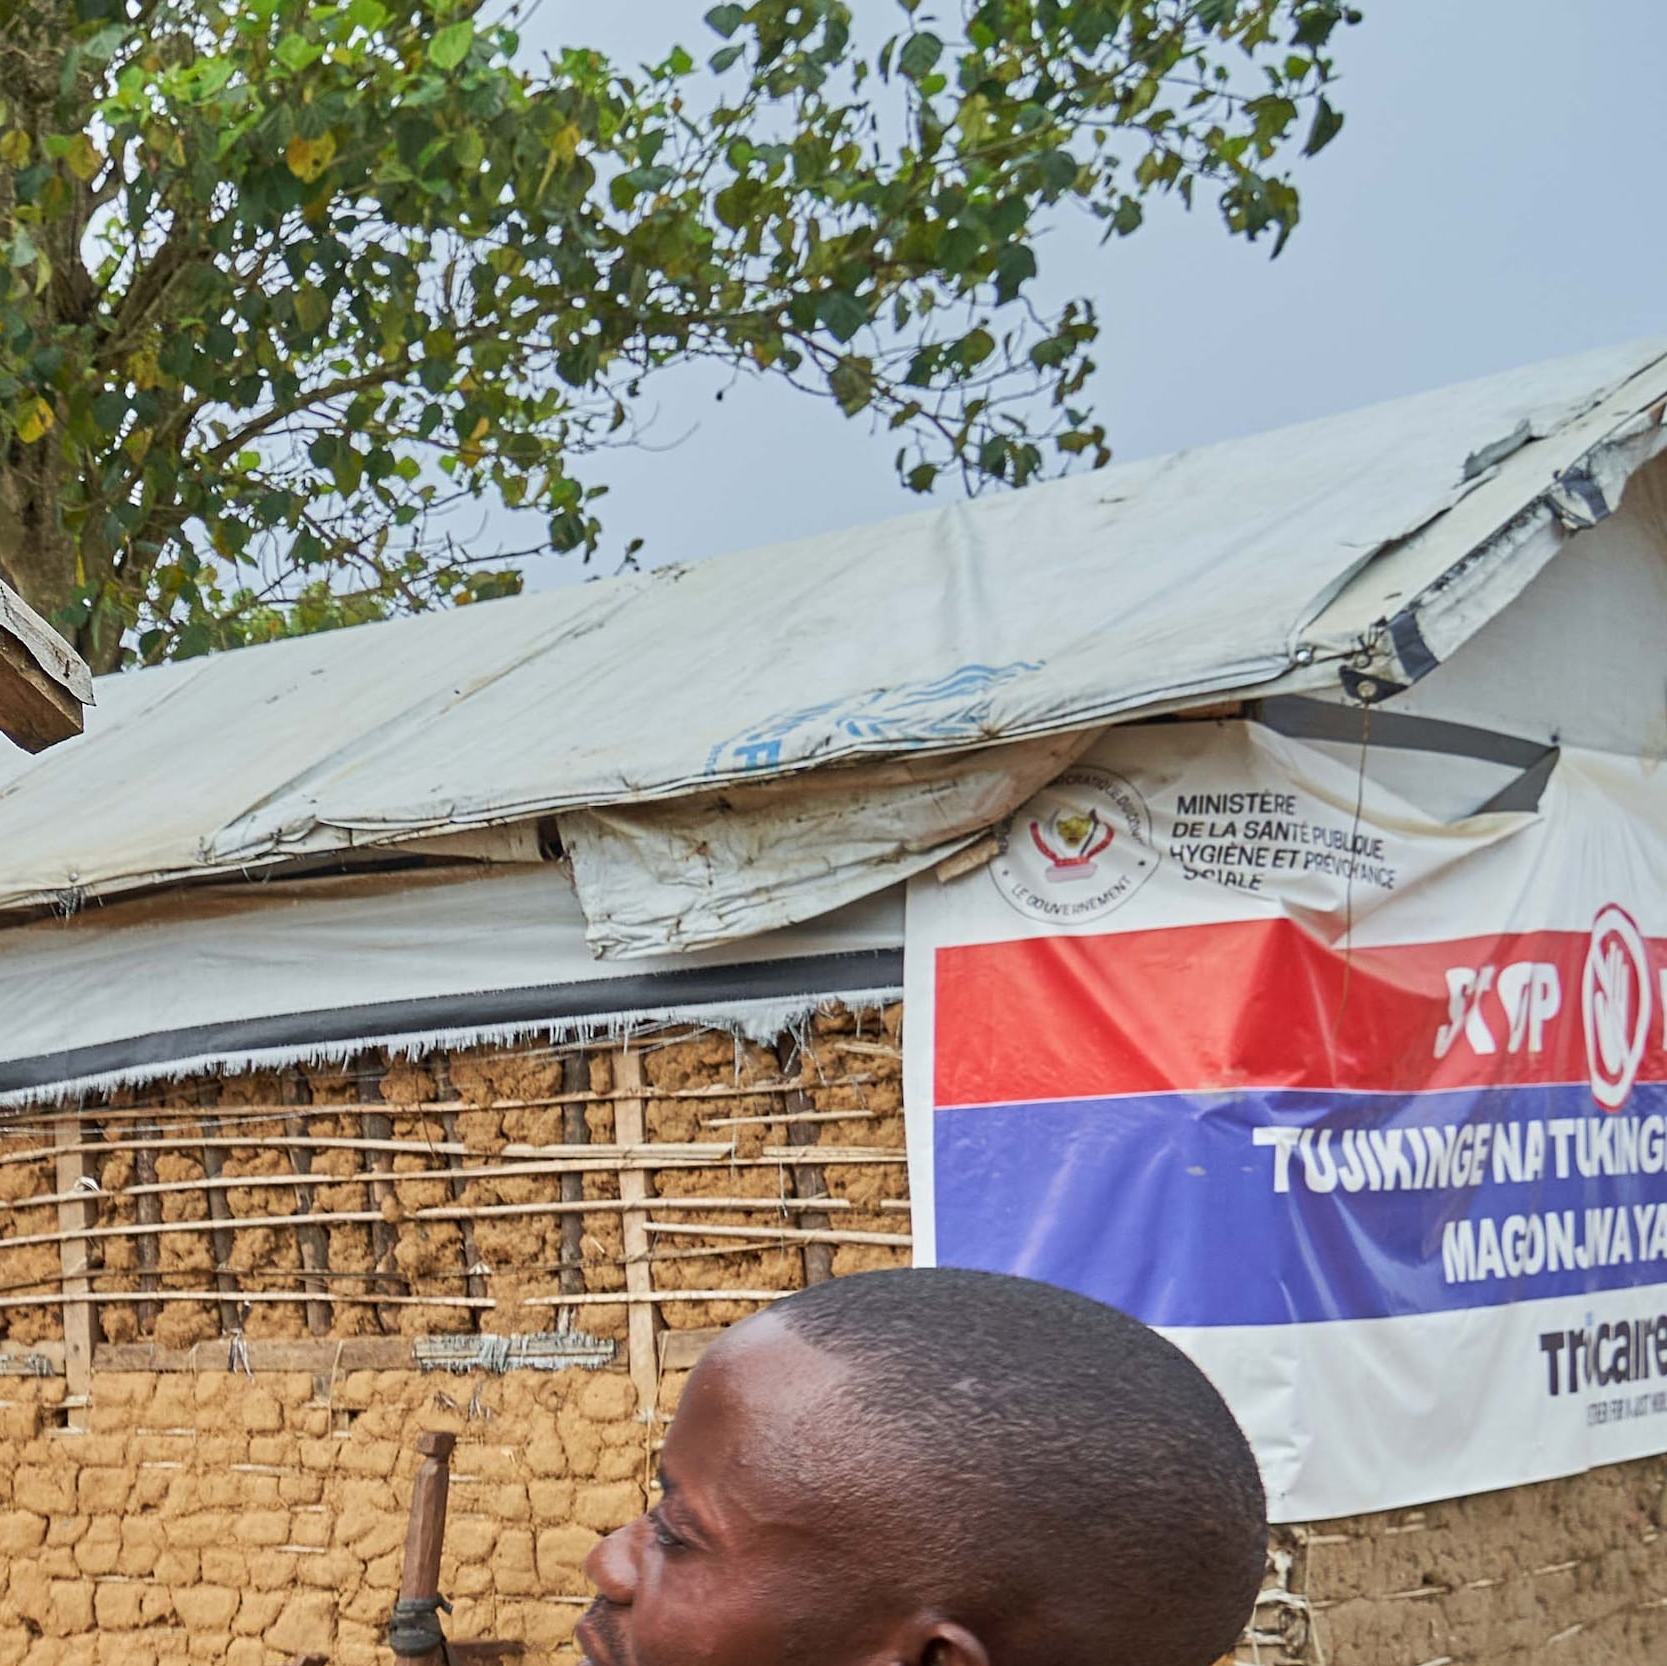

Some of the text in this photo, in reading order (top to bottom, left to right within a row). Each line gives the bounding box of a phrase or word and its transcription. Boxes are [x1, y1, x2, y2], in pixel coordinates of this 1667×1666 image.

[1177, 789, 1297, 816] MINISTÈRE
[1170, 842, 1267, 868] HYGIÈNE
[1271, 849, 1300, 868] ET
[1172, 820, 1386, 861] DE LA SANTÉ PUBLQUE,
[1253, 1123, 1491, 1193] TUJIKINGE
[1547, 1115, 1667, 1178] TUKING
